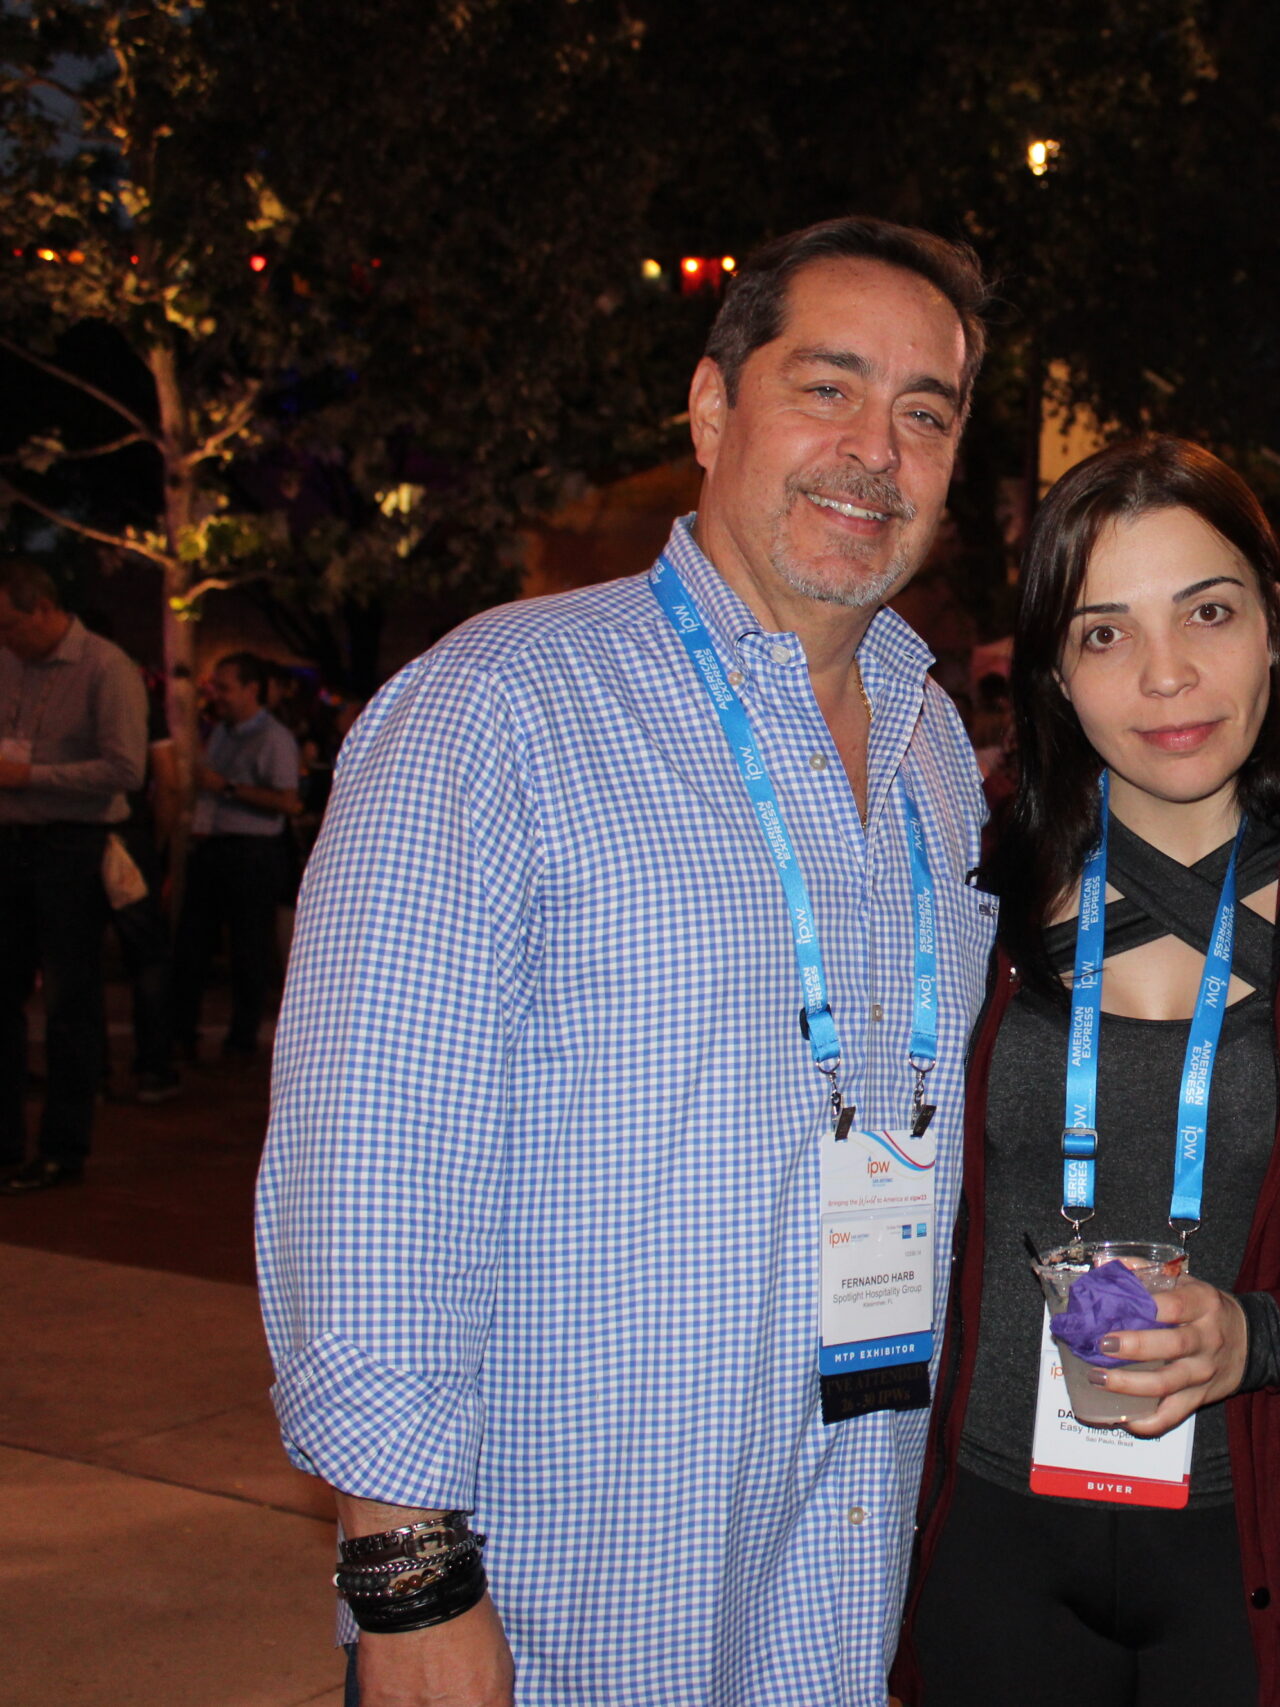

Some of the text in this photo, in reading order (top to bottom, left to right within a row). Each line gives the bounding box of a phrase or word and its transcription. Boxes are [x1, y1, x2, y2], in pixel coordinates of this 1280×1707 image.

[672, 605, 700, 634] ipw
[693, 649, 728, 710] AMERICAN
[703, 648, 734, 701] EXPRESS
[739, 746, 764, 781] ipw
[757, 801, 787, 869] AMERICAN
[765, 800, 791, 860] EXPRESS
[922, 887, 934, 954] AMERICAN
[1081, 878, 1092, 931] AMERICAN
[1091, 876, 1100, 923] EXPRESS
[795, 908, 814, 944] ipw
[917, 894, 927, 953] EXPRESS
[1214, 906, 1230, 957] EXPRESS
[1222, 904, 1235, 961] AMERICAN
[803, 967, 816, 1014] ERICAN
[810, 965, 823, 1009] PRESS
[918, 974, 936, 1010] ipw
[1075, 961, 1097, 988] ipw
[1205, 975, 1227, 1008] ipw
[1072, 1006, 1084, 1067] AMERICAN
[1082, 1006, 1093, 1059] EXPRESS
[1185, 1045, 1202, 1104] EXPRESS
[1195, 1040, 1213, 1106] AMERICAN
[1181, 1125, 1204, 1160] ipw
[867, 1157, 890, 1178] ipw
[1078, 1161, 1087, 1207] XPRES
[829, 1228, 850, 1248] ipw
[832, 1284, 922, 1304] Spotlight Hospitality Group
[842, 1271, 915, 1289] FERNANDO HARB
[835, 1344, 915, 1363] MTP EXHIBITOR
[1050, 1361, 1065, 1380] ip
[1060, 1422, 1083, 1434] Easy
[1087, 1481, 1133, 1494] BUYER
